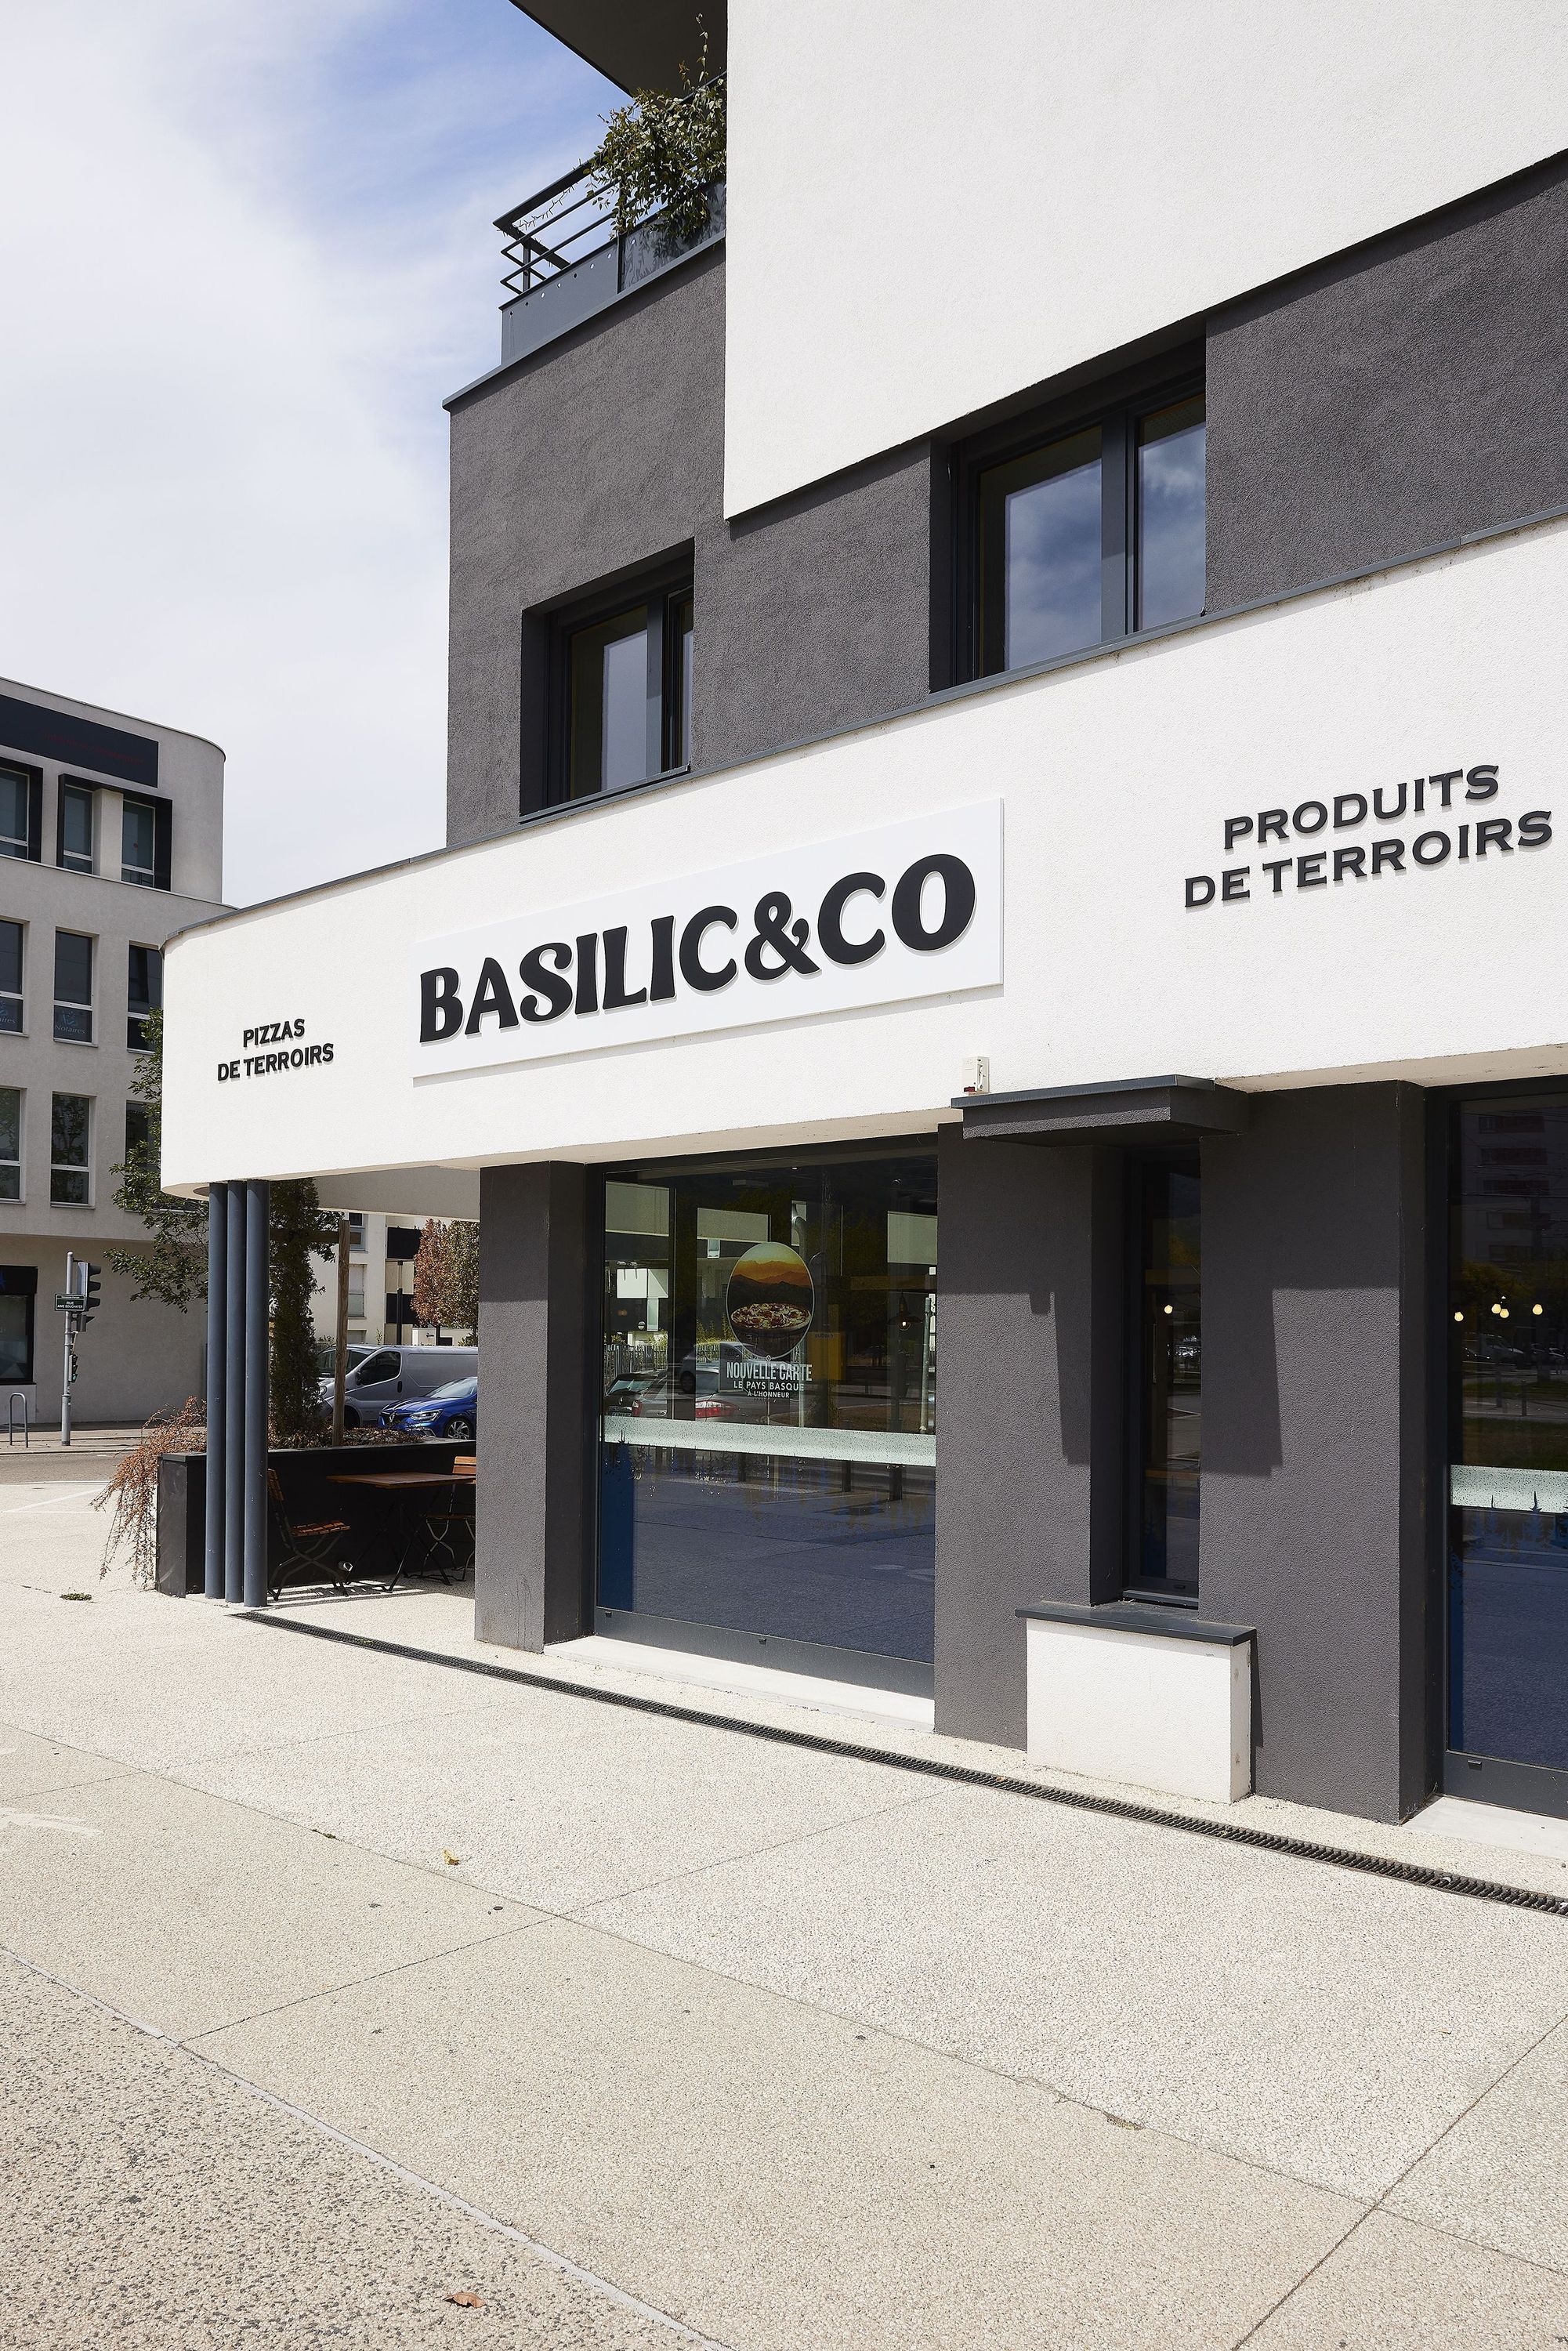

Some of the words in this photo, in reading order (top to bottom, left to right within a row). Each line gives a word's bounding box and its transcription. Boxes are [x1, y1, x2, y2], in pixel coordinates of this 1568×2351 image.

[1223, 764, 1499, 850] PRODUITS
[1184, 865, 1251, 908] DE
[1262, 810, 1552, 893] TERROIRS
[419, 853, 976, 1043] BASILIC&CO
[55, 1024, 86, 1034] Notaires
[243, 1018, 305, 1048] PIZZAS
[217, 1060, 241, 1081] DE
[243, 1042, 334, 1077] TERROIRS
[726, 1361, 777, 1380] NOUVELLE
[779, 1363, 813, 1382] CARTE
[746, 1381, 766, 1389] PAYS
[769, 1382, 805, 1391] BASQUE
